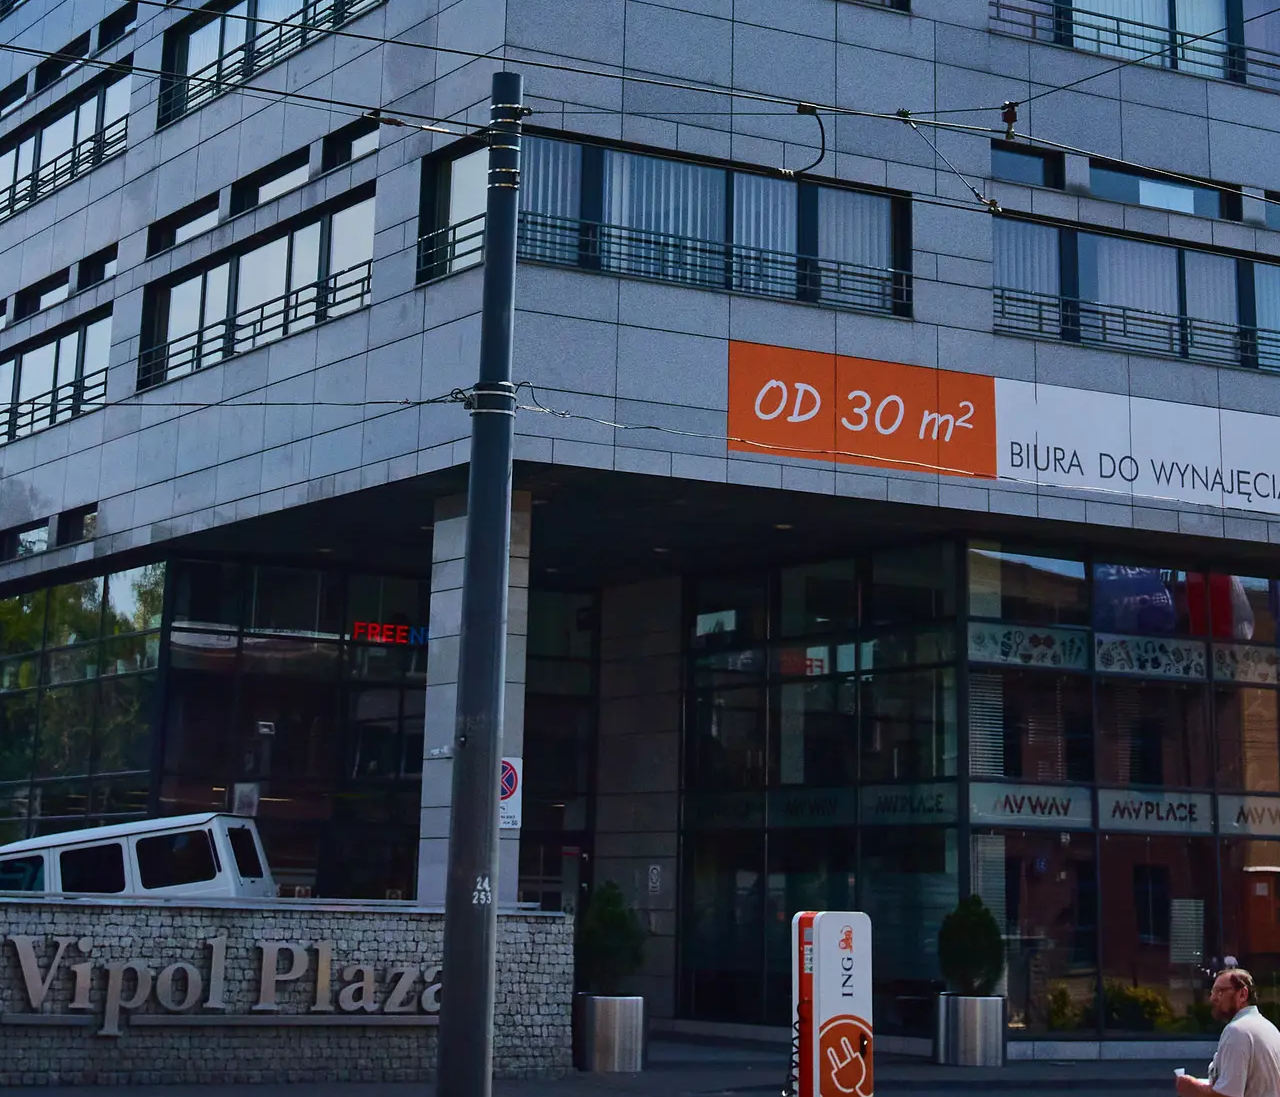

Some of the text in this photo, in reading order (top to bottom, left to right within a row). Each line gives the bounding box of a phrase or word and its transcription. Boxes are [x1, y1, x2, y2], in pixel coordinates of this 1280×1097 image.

[754, 378, 821, 423] OD
[841, 390, 905, 435] 30
[1010, 441, 1084, 476] BIURA
[1099, 452, 1139, 482] DO
[353, 621, 428, 645] FREEN
[472, 891, 492, 904] 253
[476, 876, 490, 891] 24
[7, 935, 228, 1037] Vipol
[841, 957, 854, 998] ING
